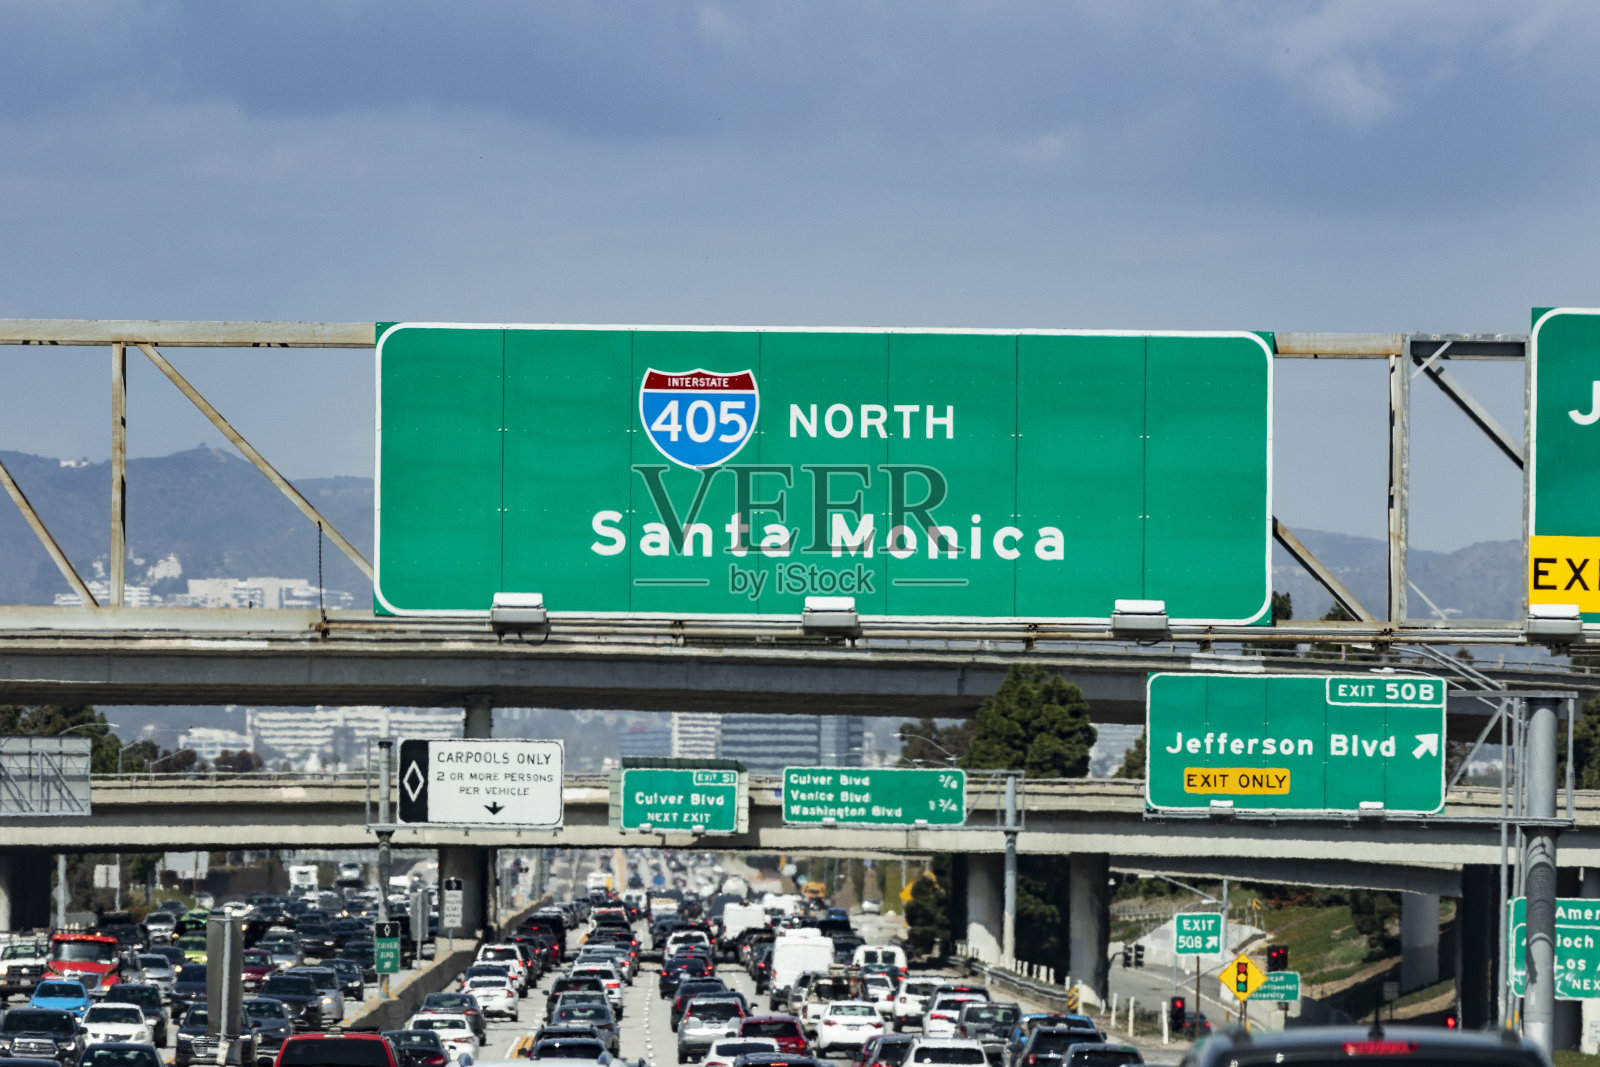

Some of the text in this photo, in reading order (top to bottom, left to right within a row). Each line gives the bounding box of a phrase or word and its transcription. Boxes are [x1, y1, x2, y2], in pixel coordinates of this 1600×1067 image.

[667, 377, 730, 388] INTERSTATE
[1567, 380, 1600, 425] J
[650, 399, 748, 443] 405
[789, 403, 955, 440] NORTH
[590, 510, 1066, 561] Santa Monica
[1532, 557, 1600, 592] EX
[1337, 683, 1435, 701] EXIT 50B
[1166, 732, 1396, 758] Jefferson Blvd
[437, 752, 552, 765] CARPOOLS ONLY
[436, 772, 554, 783] 2 OR MORE PERSONS
[697, 773, 734, 782] EXIT 51
[790, 773, 870, 786] Culver Blvd
[1187, 773, 1287, 789] EXIT ONLY
[459, 786, 530, 796] PER VEHICLE
[635, 791, 725, 806] Culver Blvd
[790, 789, 871, 803] Venice Blvd
[647, 812, 711, 823] NEXT EXIT
[790, 804, 902, 819] Washington Blvd
[1182, 919, 1215, 931] EXIT
[1178, 935, 1202, 949] 50B
[1554, 955, 1587, 971] Los
